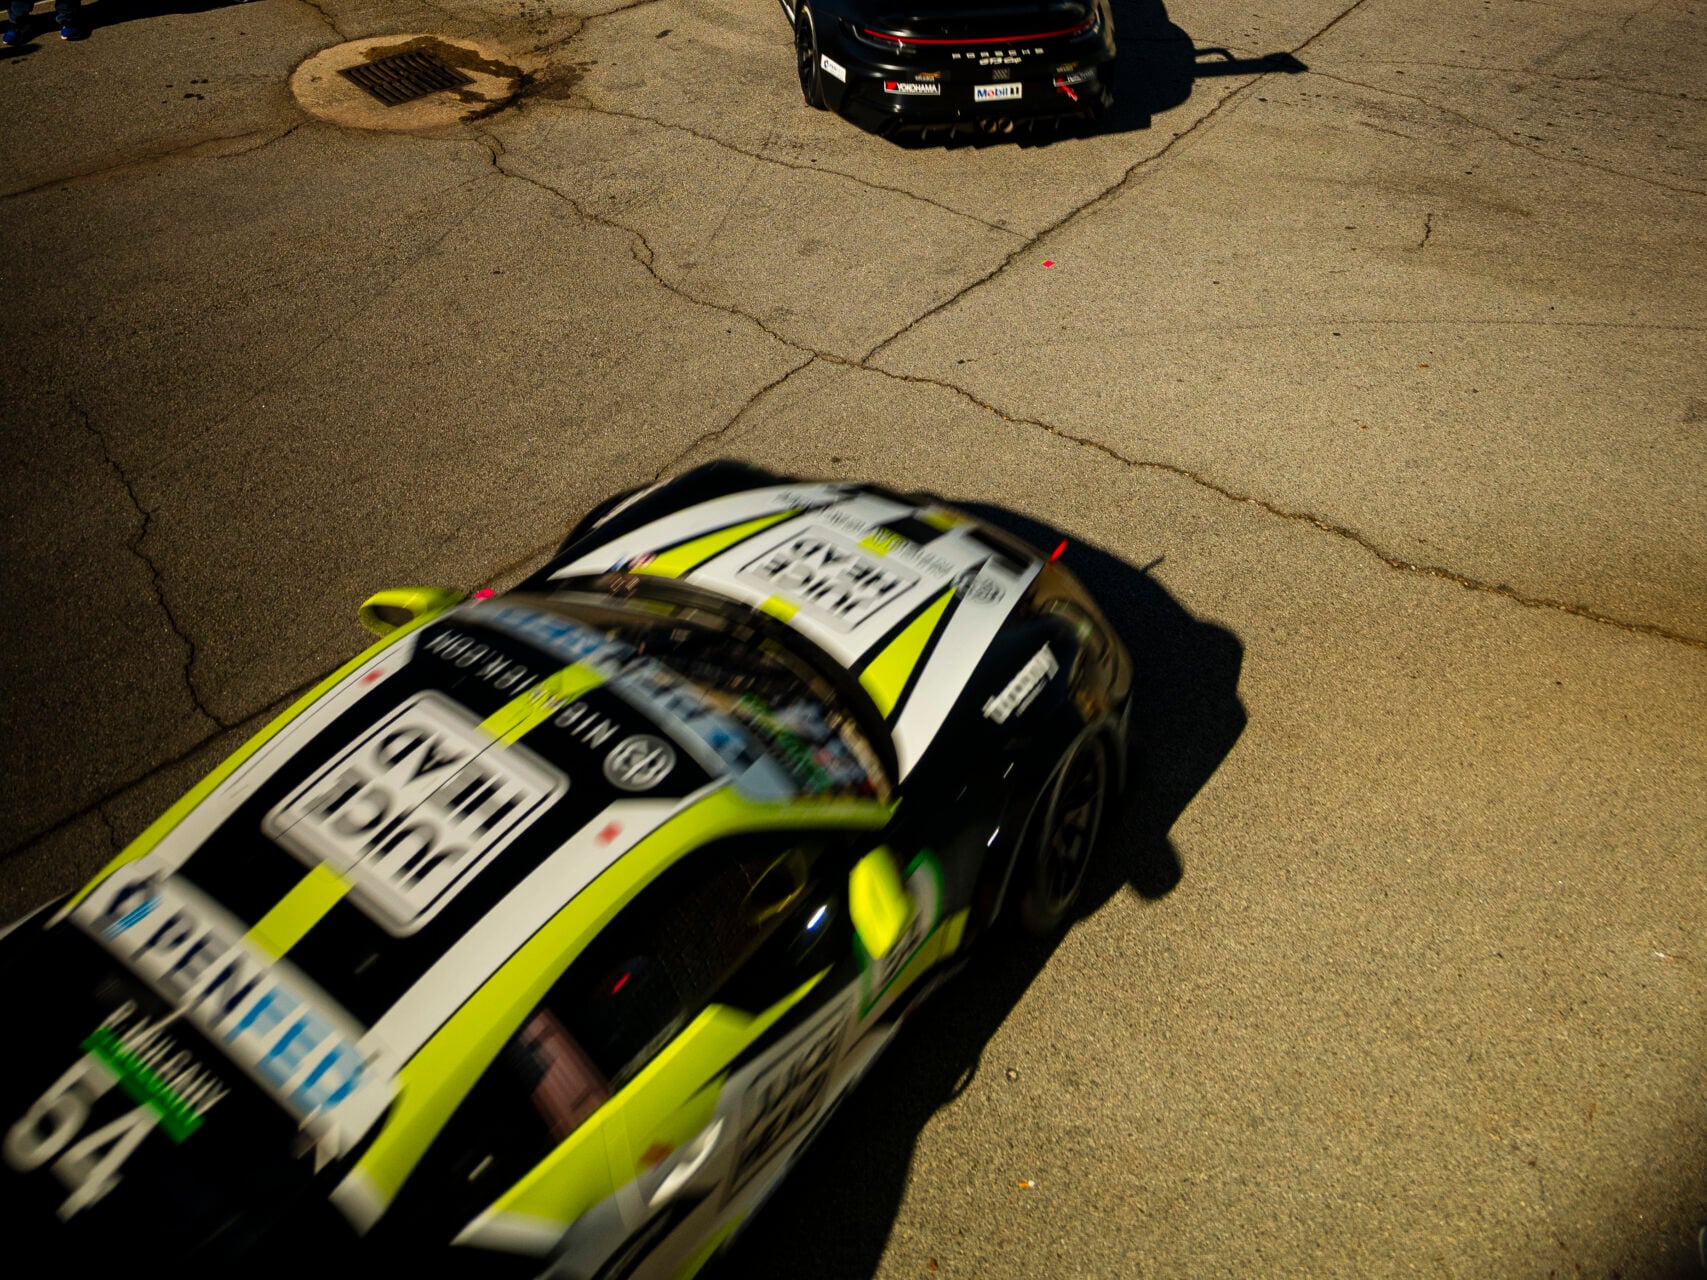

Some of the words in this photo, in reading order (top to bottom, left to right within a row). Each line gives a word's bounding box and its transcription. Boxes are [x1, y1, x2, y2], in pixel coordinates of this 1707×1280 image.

[897, 82, 938, 93] YOKOHAMA
[976, 87, 1008, 98] Mobil
[763, 555, 864, 616] JUICE
[791, 536, 901, 597] HEAD
[374, 722, 533, 840] HEAD
[302, 760, 470, 894] JUICE
[131, 902, 376, 1114] PENFED
